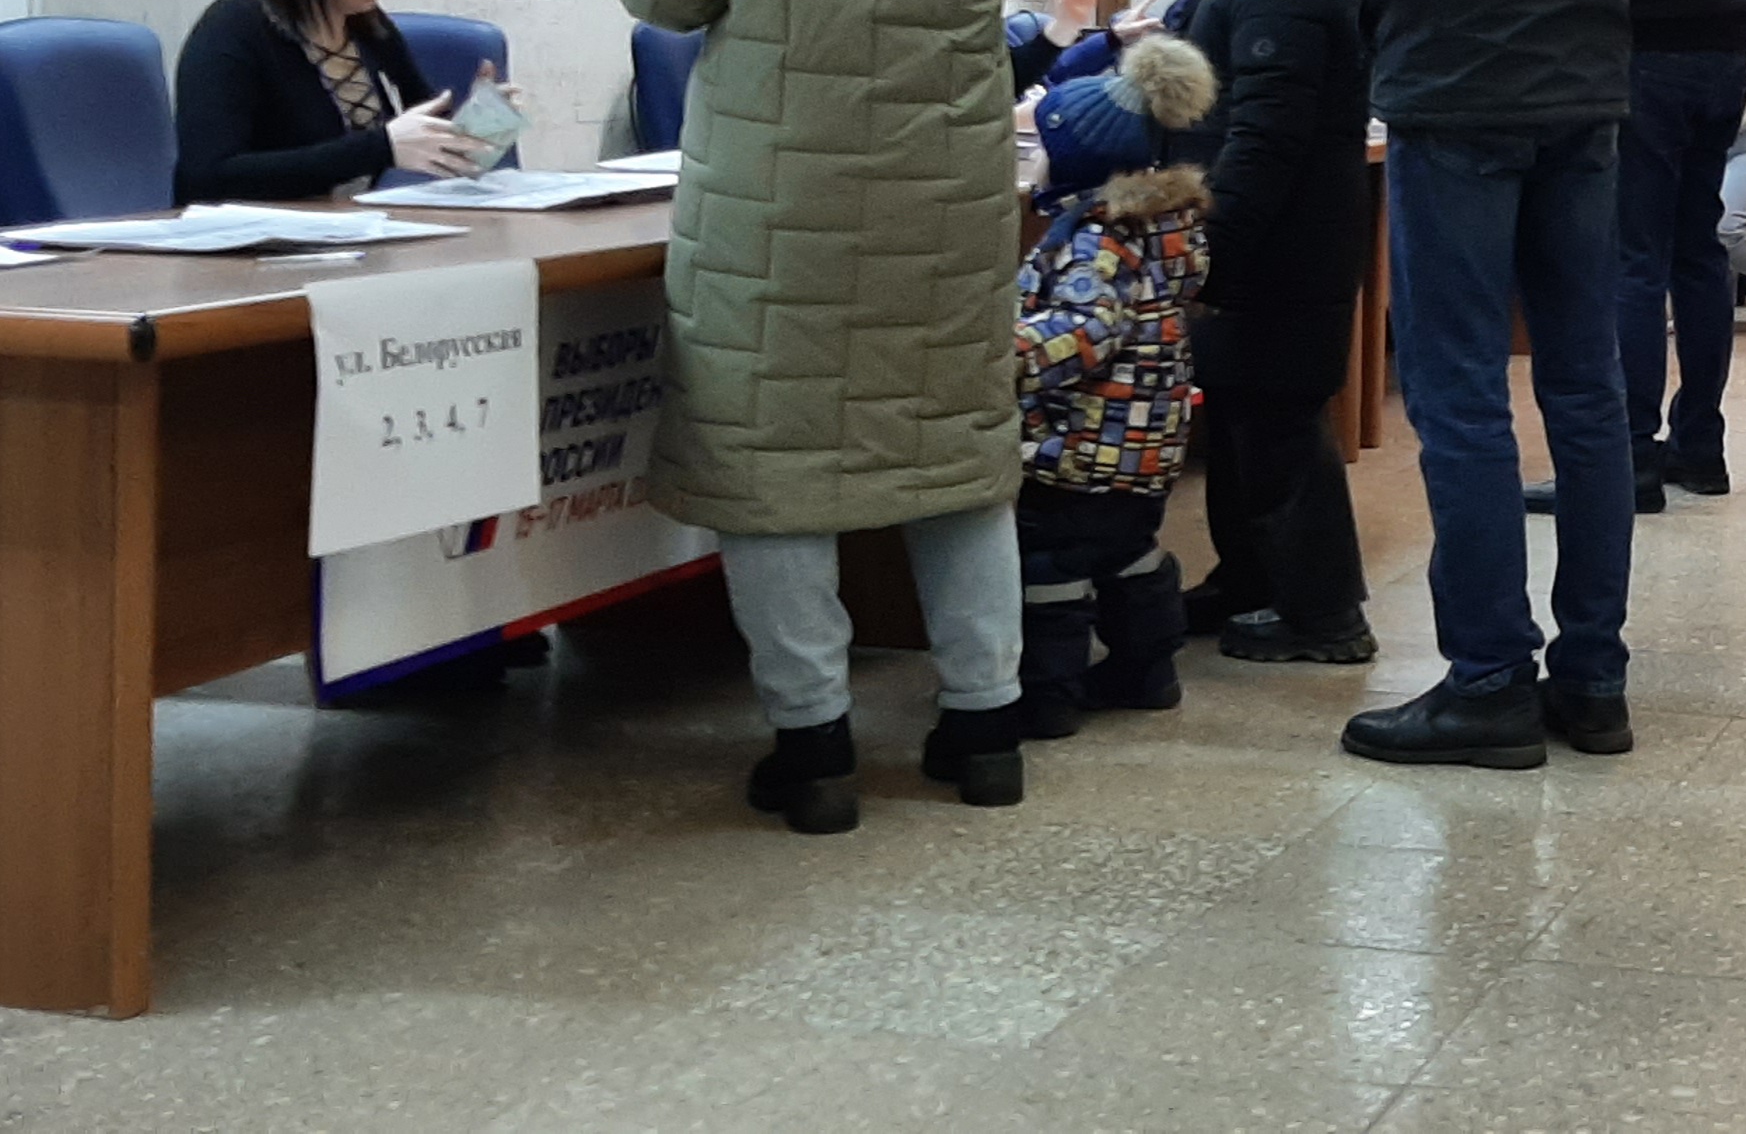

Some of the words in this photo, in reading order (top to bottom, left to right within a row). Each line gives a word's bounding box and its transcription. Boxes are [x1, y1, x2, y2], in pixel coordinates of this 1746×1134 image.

[334, 351, 373, 387] ул.
[379, 328, 522, 371] Белорусская
[552, 324, 662, 379] ВЫБОРЫ
[476, 396, 489, 429] 7
[540, 431, 628, 486] ОССИИ
